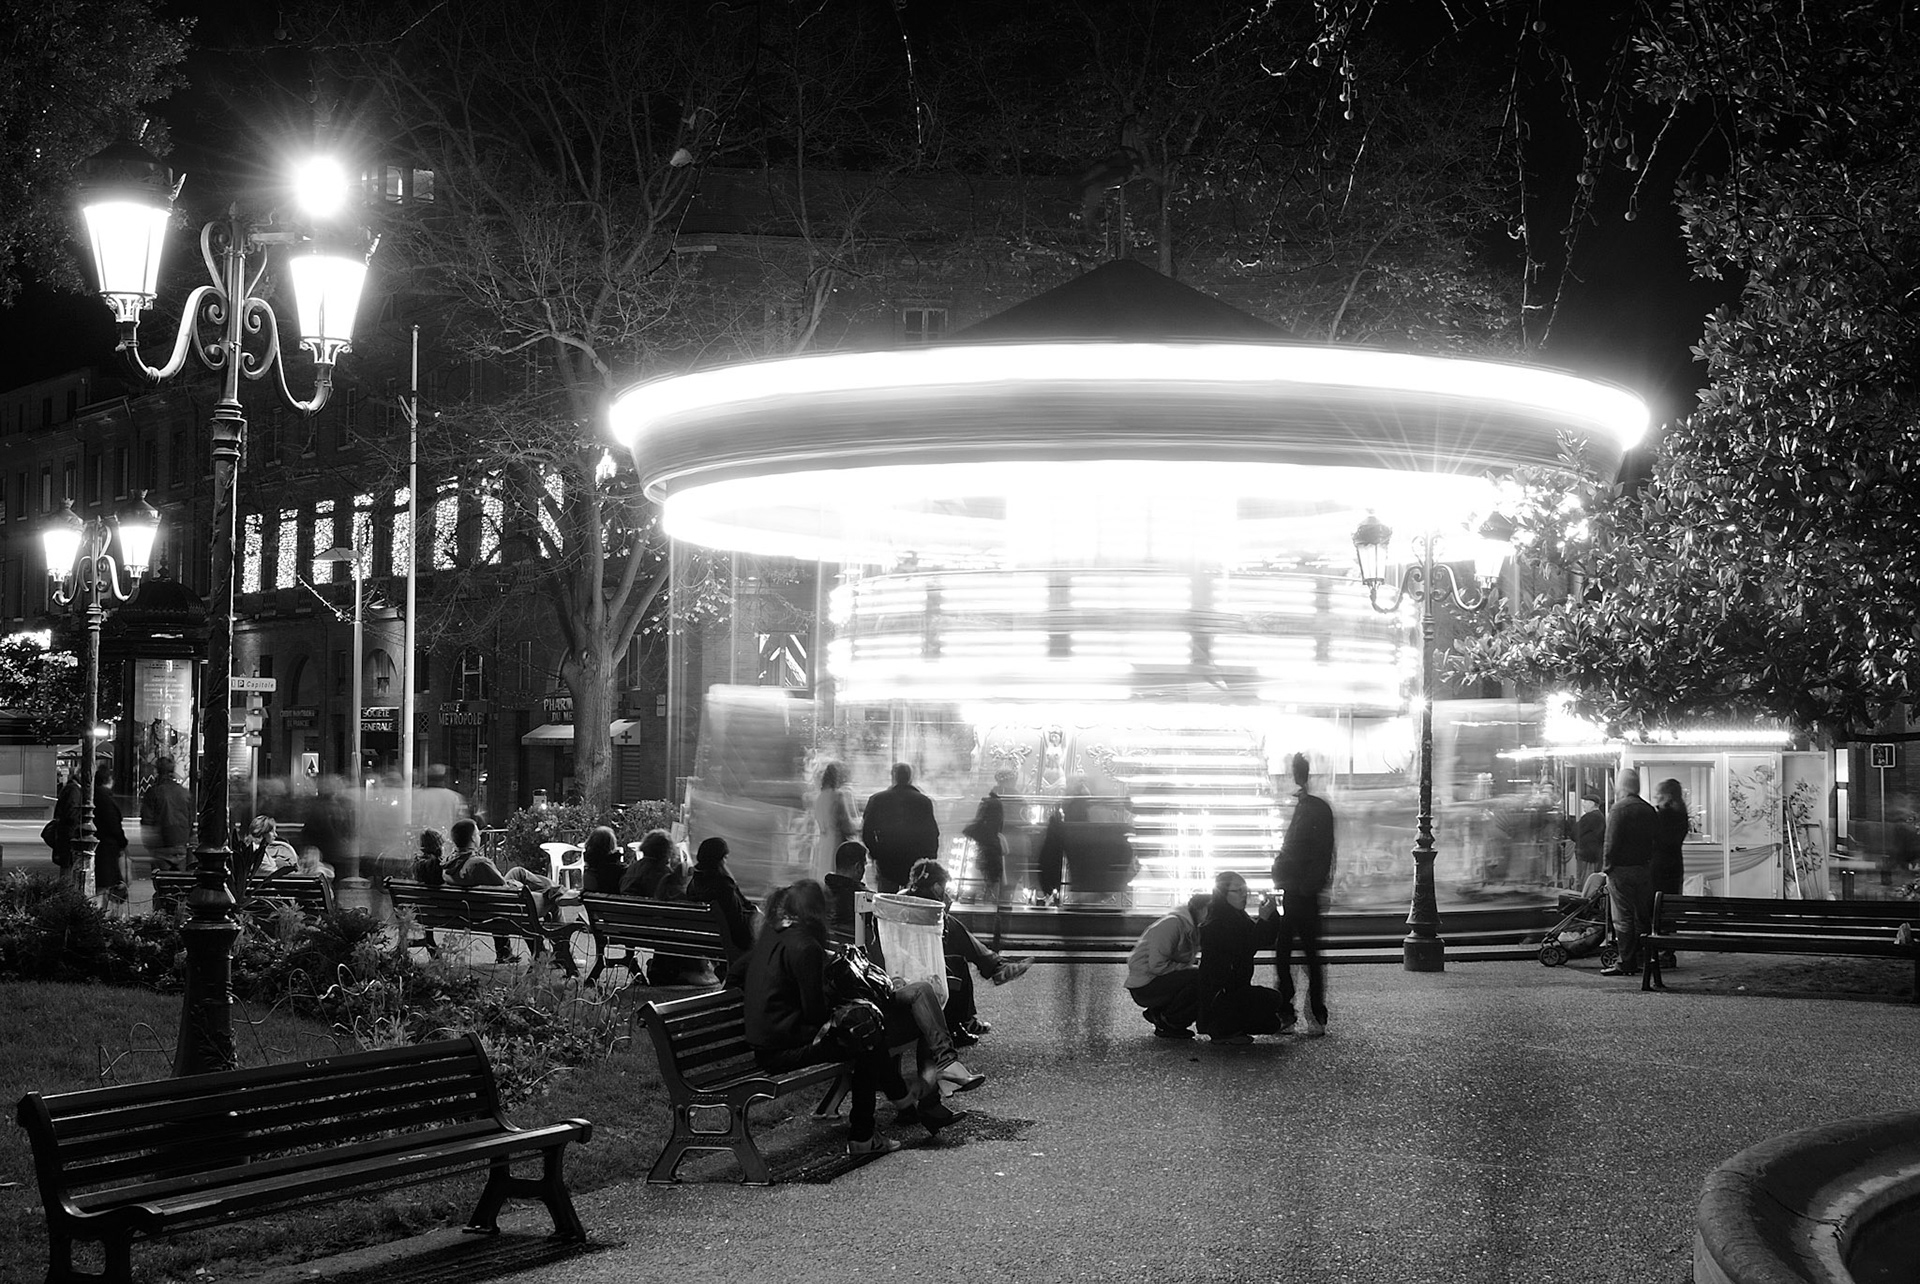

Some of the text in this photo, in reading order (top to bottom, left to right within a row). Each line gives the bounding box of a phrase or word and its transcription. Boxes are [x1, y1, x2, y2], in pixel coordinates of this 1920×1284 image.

[247, 681, 274, 689] Capitole
[439, 712, 483, 725] METROPOLE
[552, 712, 561, 722] DU
